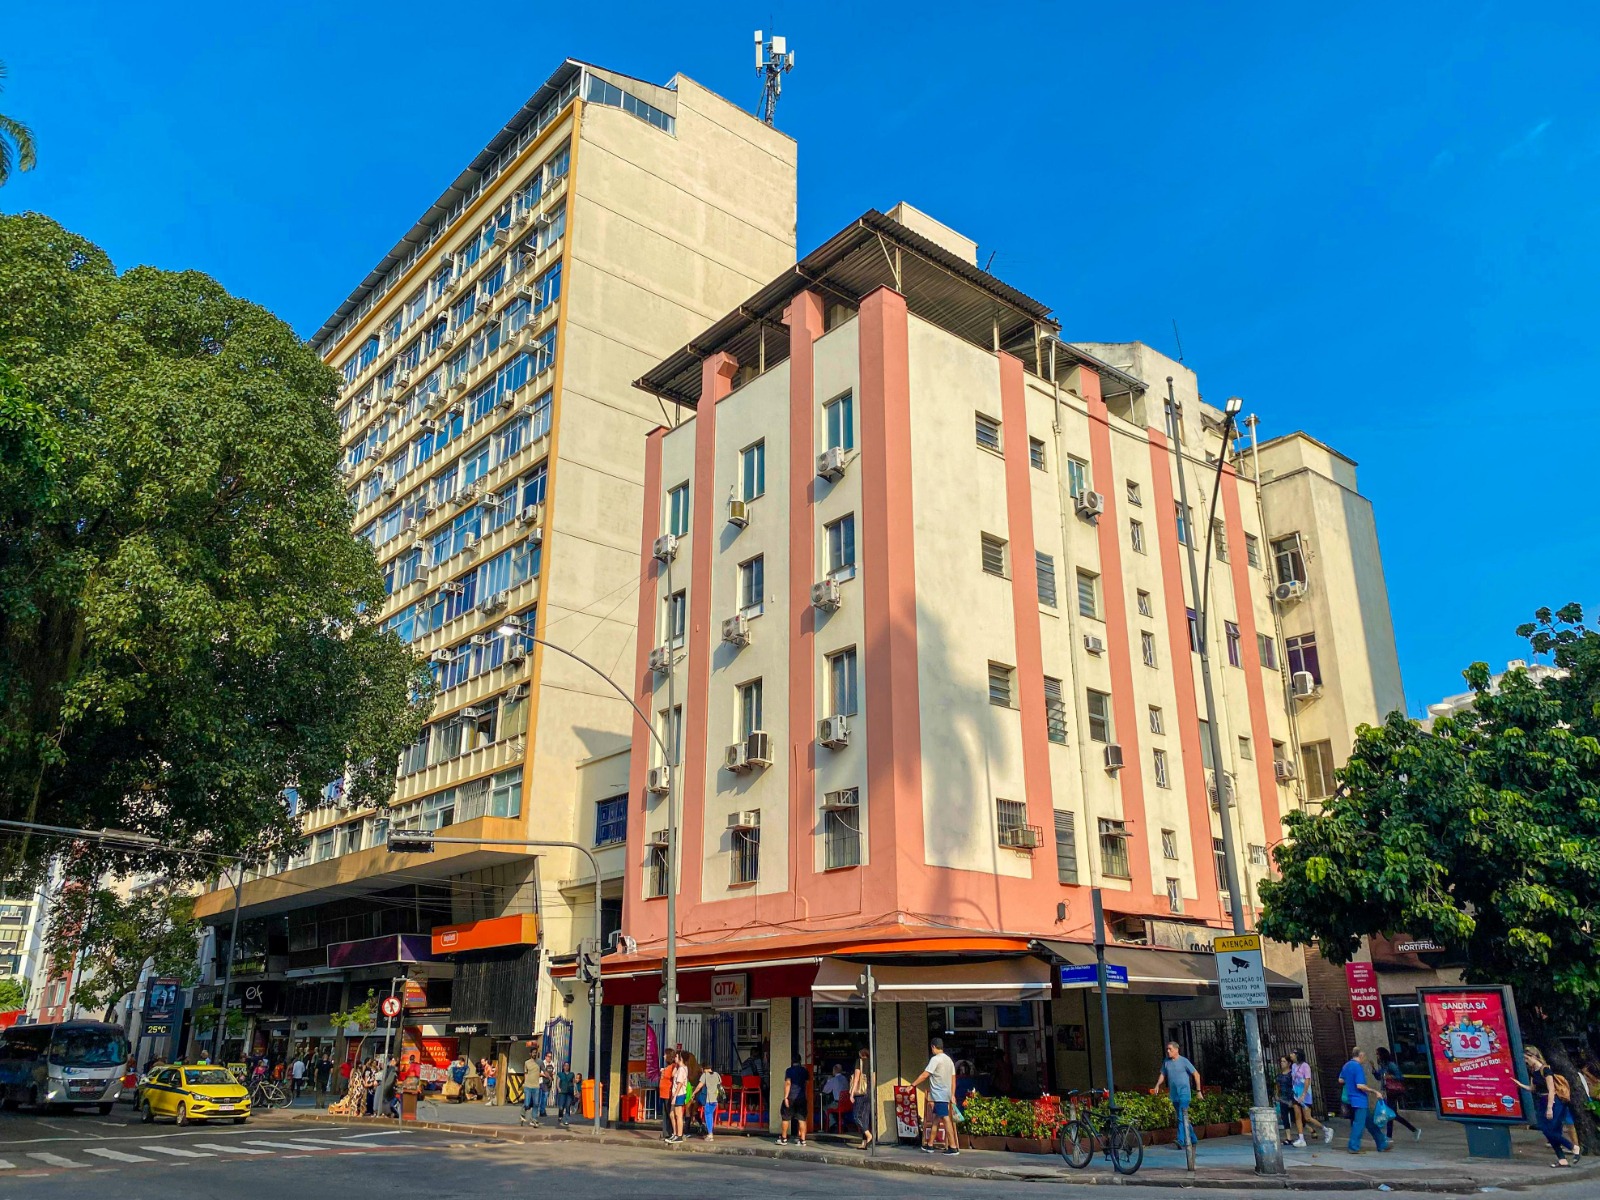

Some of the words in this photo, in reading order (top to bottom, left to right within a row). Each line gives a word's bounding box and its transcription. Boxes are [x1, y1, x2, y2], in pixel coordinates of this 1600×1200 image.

[1222, 938, 1253, 948] ATENÇÃO
[1442, 1002, 1475, 1010] SANDRA
[1357, 1004, 1376, 1018] 39
[1461, 1063, 1480, 1072] VOLTA
